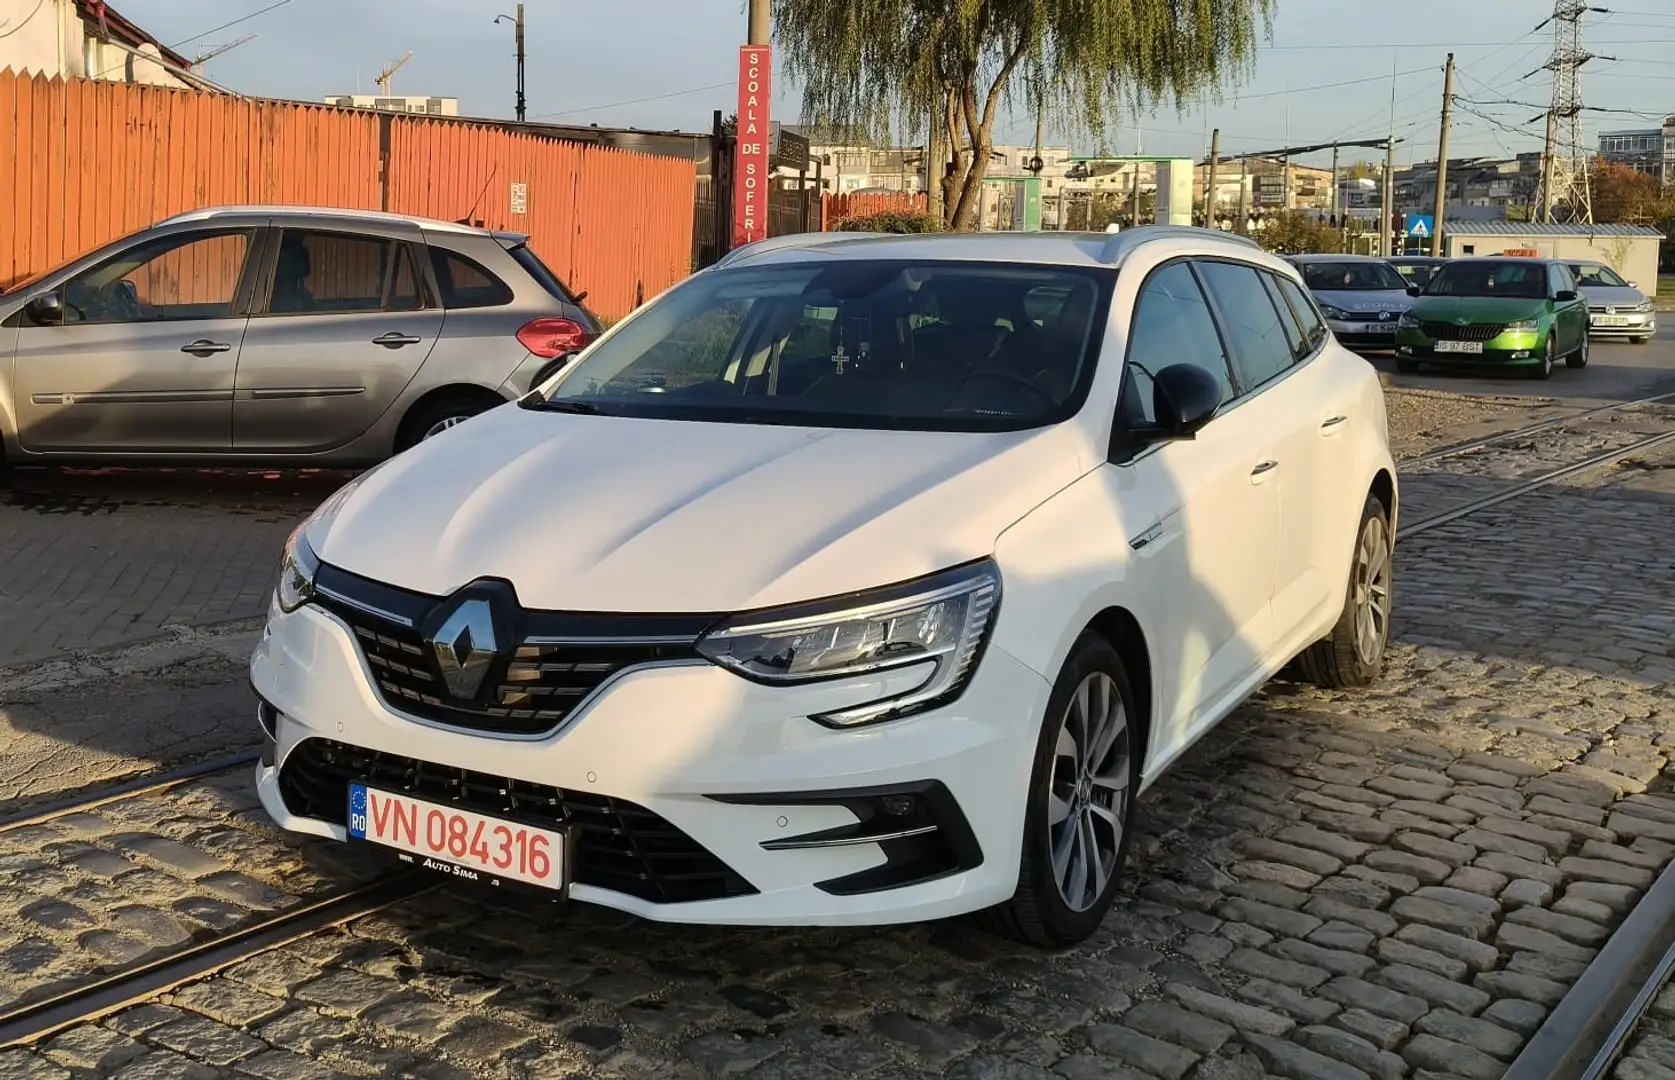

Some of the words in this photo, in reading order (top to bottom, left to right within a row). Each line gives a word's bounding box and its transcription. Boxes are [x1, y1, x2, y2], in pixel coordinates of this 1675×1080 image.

[747, 53, 758, 135] SCOALA
[742, 143, 761, 155] DE
[745, 163, 757, 243] SOFERI
[352, 813, 366, 831] RO
[370, 793, 417, 847] VN
[426, 809, 550, 879] 084316
